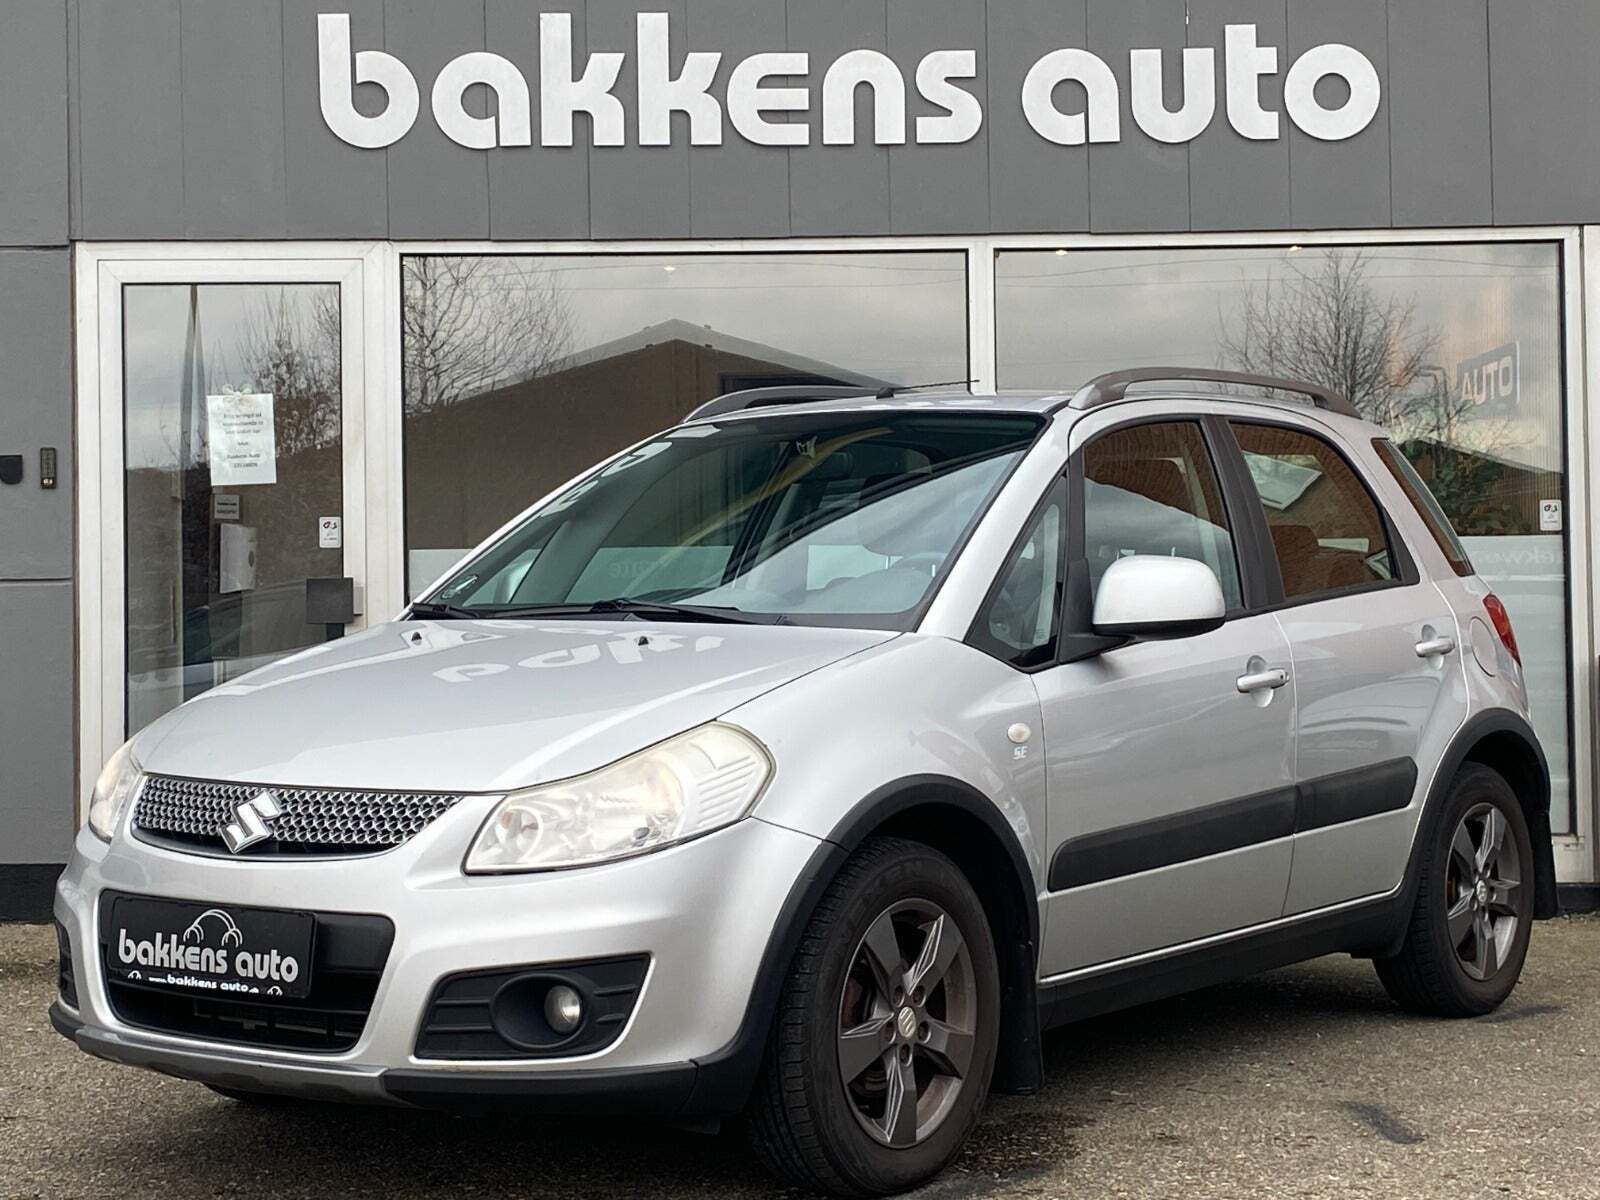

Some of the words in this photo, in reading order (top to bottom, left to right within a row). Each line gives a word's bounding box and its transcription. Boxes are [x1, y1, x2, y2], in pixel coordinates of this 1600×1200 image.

[317, 12, 983, 150] bakkens
[1021, 23, 1381, 146] auto
[1461, 356, 1513, 405] AUTO
[118, 928, 228, 974] bakkens
[235, 949, 299, 983] auto
